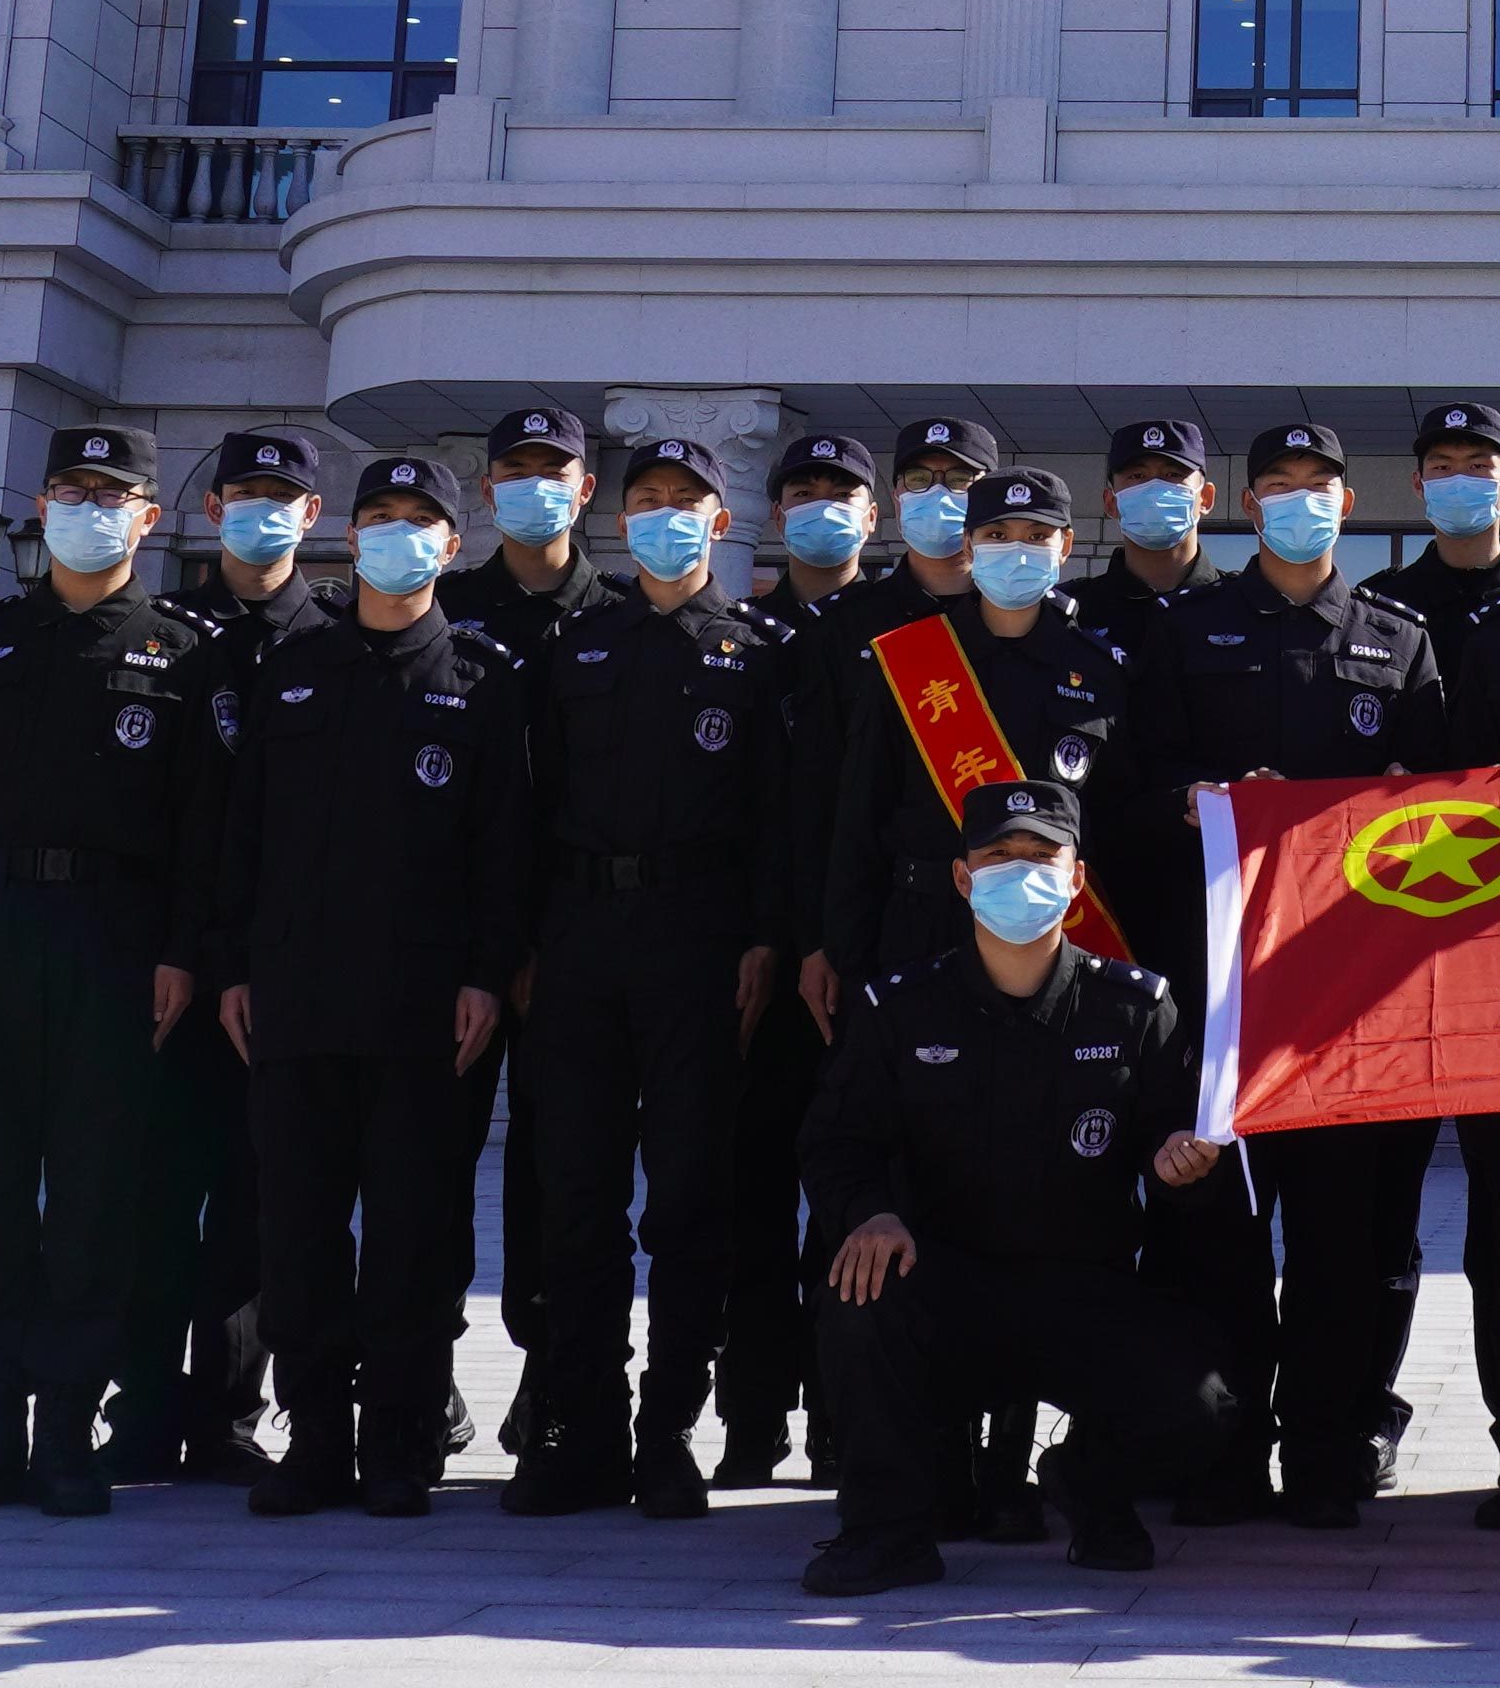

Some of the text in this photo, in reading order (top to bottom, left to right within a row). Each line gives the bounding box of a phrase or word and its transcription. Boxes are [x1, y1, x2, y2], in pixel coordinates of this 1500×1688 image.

[124, 652, 168, 669] 026760
[917, 678, 998, 788] 青年
[1075, 1045, 1120, 1062] 028287
